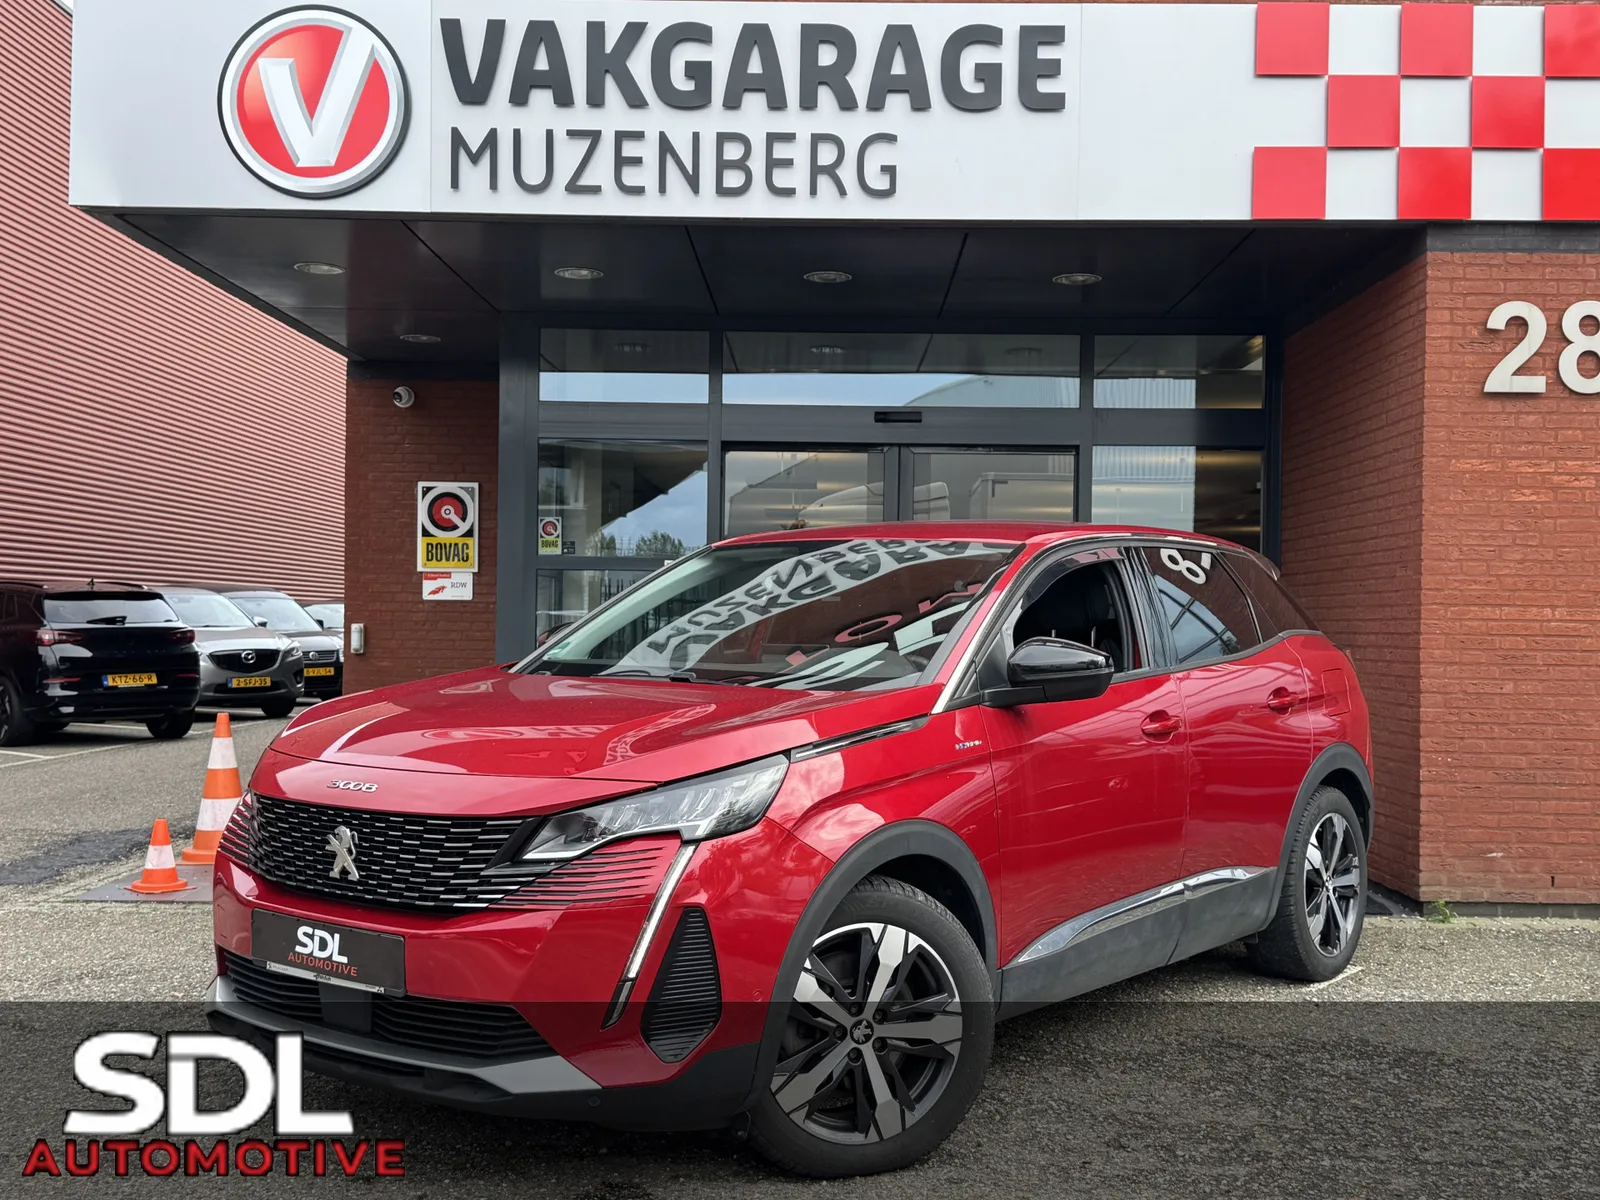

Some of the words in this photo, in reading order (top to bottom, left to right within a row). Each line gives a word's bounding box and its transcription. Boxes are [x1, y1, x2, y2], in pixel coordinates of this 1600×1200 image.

[440, 18, 1067, 112] VAKGARAGE
[258, 25, 375, 169] V
[450, 127, 898, 199] MUZENBERG
[1484, 301, 1600, 395] 28
[426, 542, 470, 562] BOVAG
[111, 675, 153, 684] KTZ-66-R
[236, 677, 268, 686] 2-SFJ-35
[326, 780, 379, 793] 3008
[294, 925, 348, 964] SDL
[287, 951, 358, 977] AUTOMOTIVE
